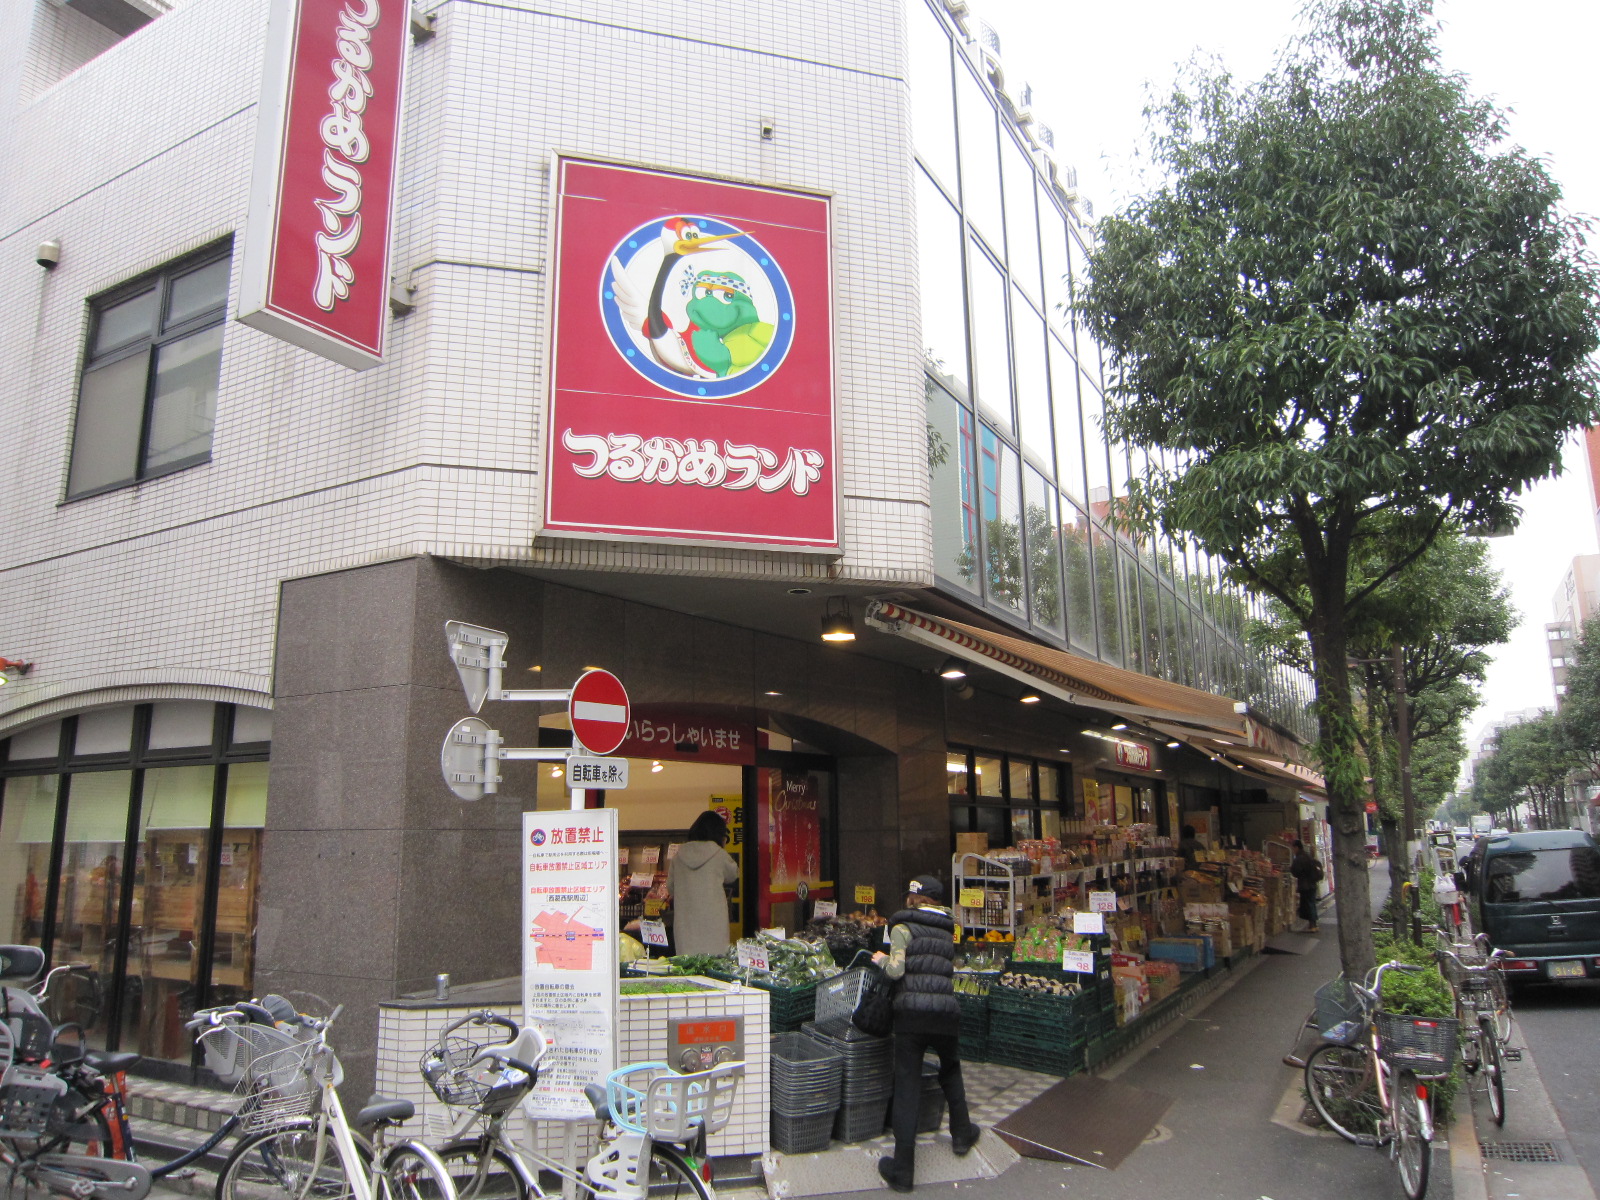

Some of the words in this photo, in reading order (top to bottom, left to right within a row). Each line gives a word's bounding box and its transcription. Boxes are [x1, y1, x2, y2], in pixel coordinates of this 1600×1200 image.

[562, 427, 824, 496] つるかめランド
[572, 763, 624, 783] 自転車を除く
[786, 780, 806, 796] Merry
[550, 826, 605, 845] 放置禁止
[529, 860, 608, 872] 自転車放置禁止区域エリア
[1096, 902, 1114, 911] 128
[649, 933, 665, 944] 100
[1076, 962, 1090, 971] 98
